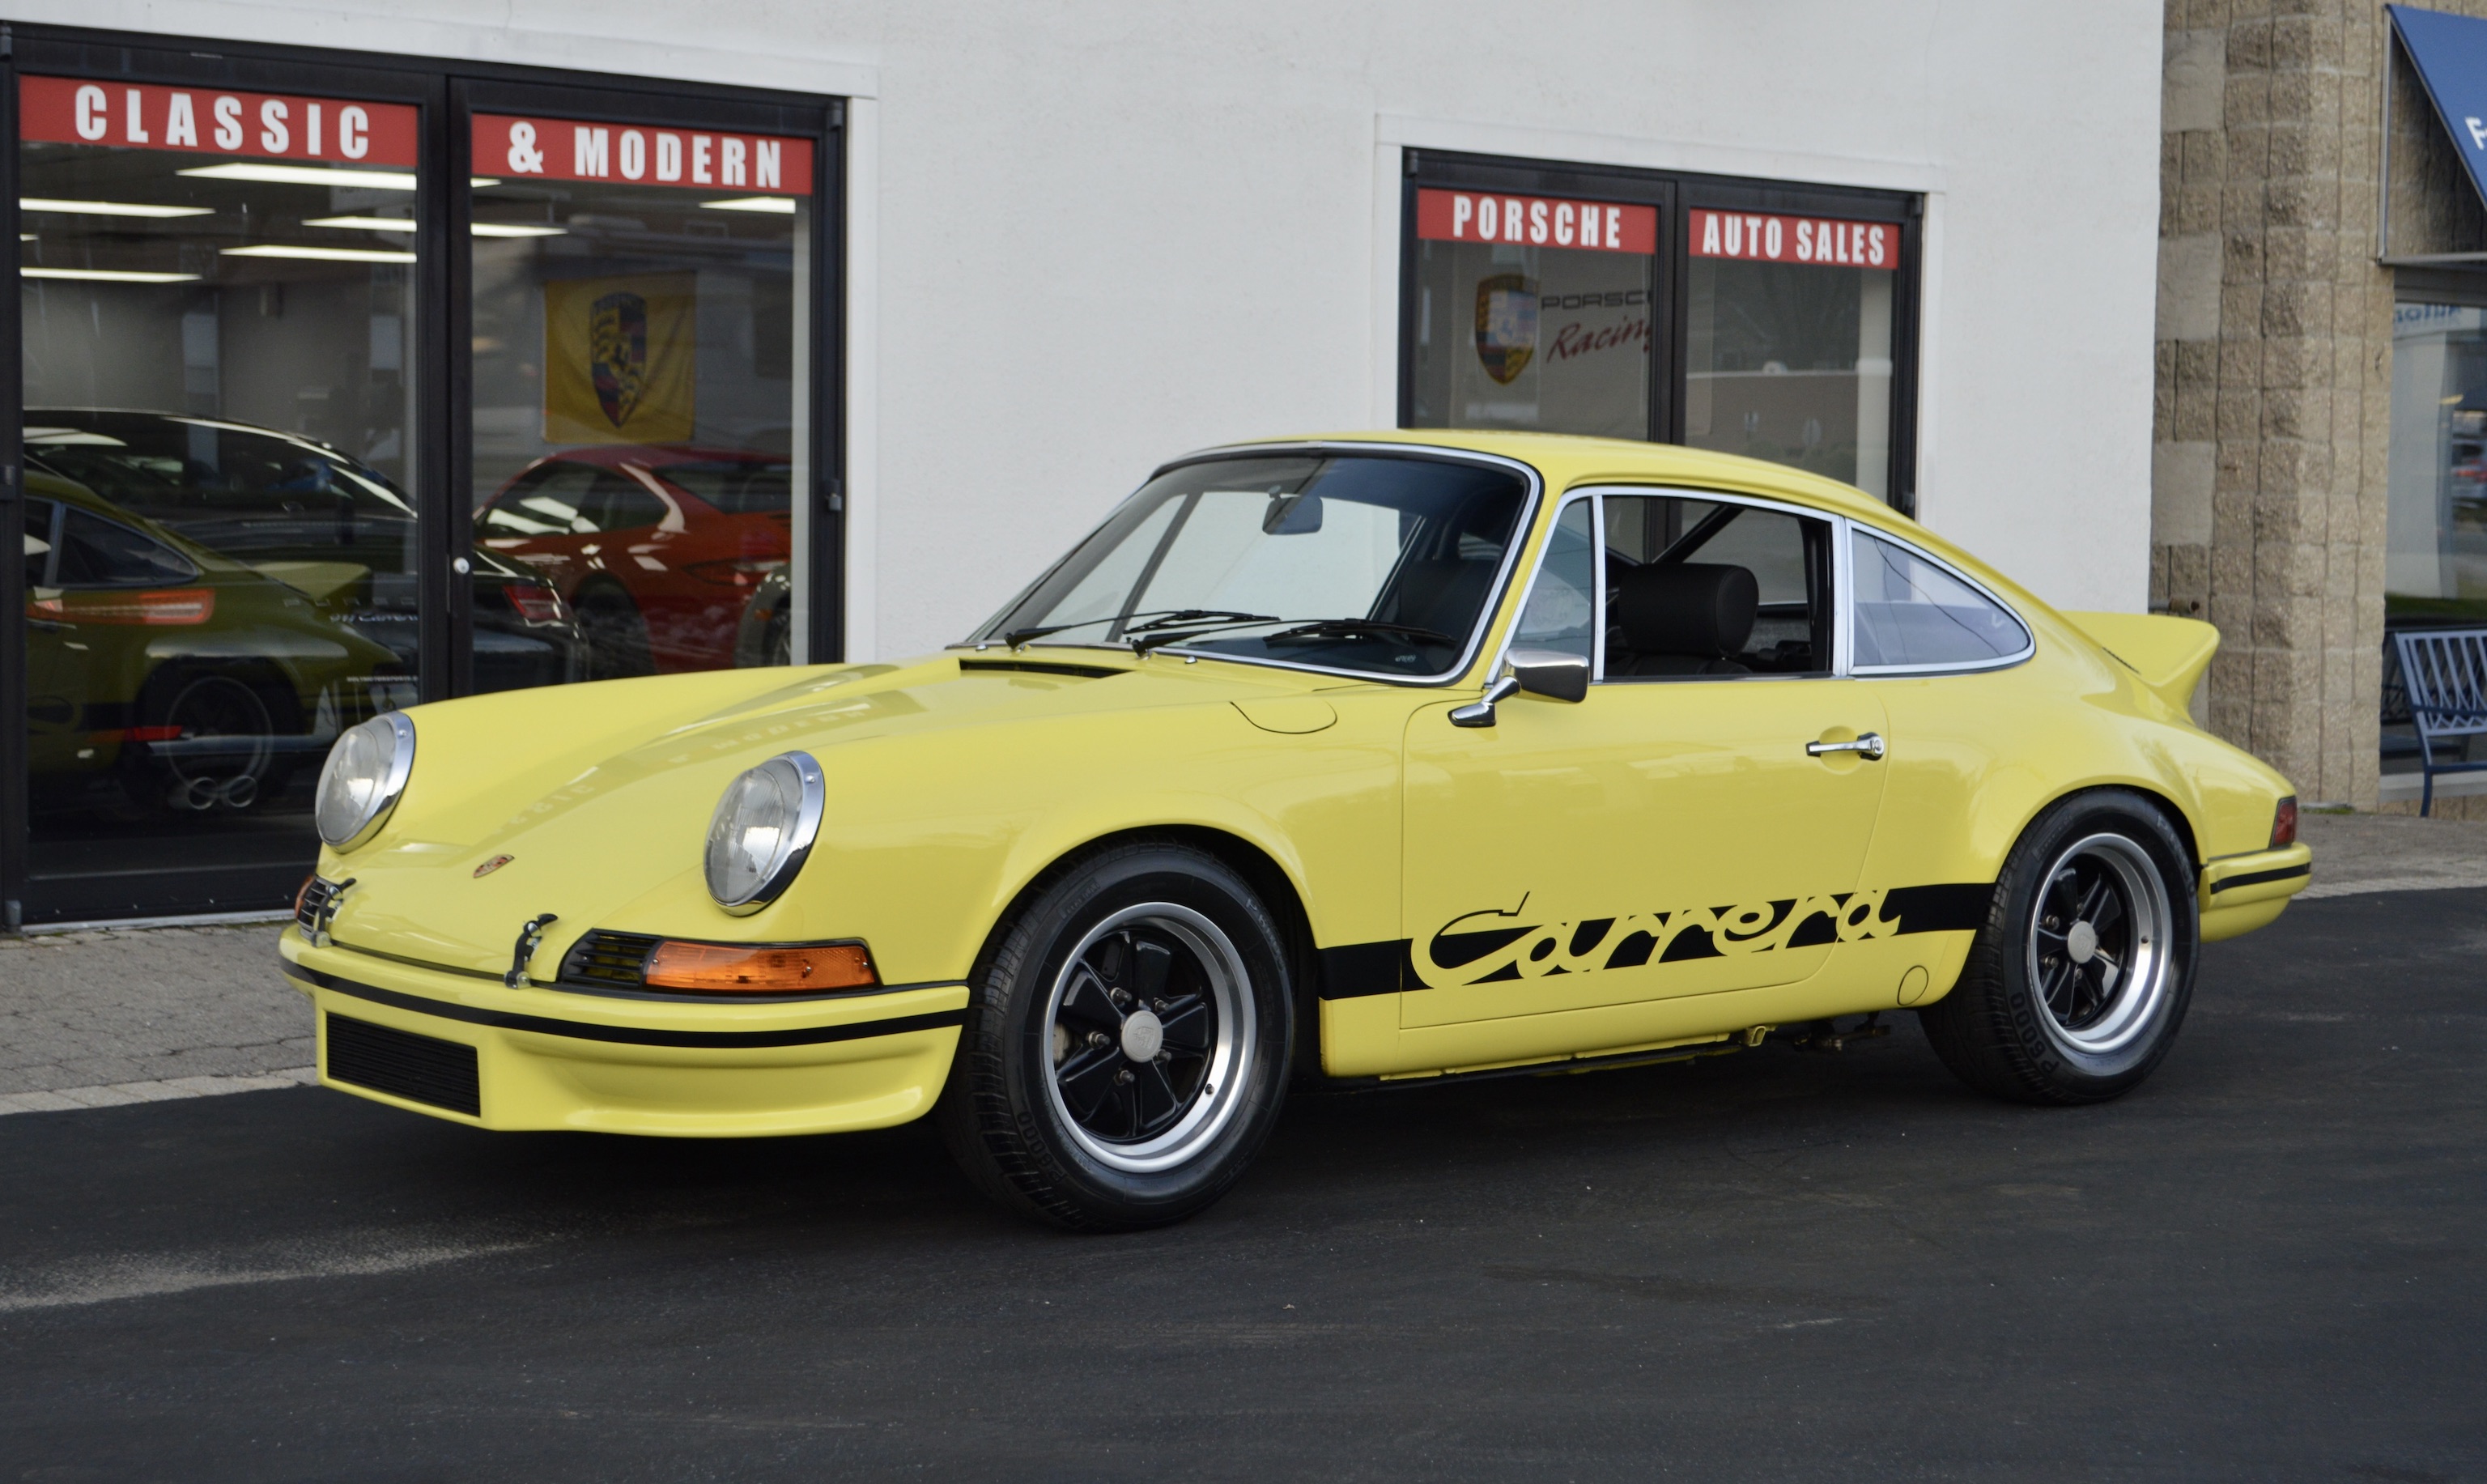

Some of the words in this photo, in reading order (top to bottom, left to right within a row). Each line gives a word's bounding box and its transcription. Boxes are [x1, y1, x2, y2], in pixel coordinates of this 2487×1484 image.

[75, 84, 370, 159] CLASSIC
[2464, 116, 2487, 151] F
[507, 121, 544, 173] &
[574, 127, 780, 189] MODERN
[1453, 195, 1621, 249] PORSCHE
[1703, 214, 1783, 259] AUTO
[1796, 220, 1885, 266] SALES
[1411, 889, 1901, 989] Carrera
